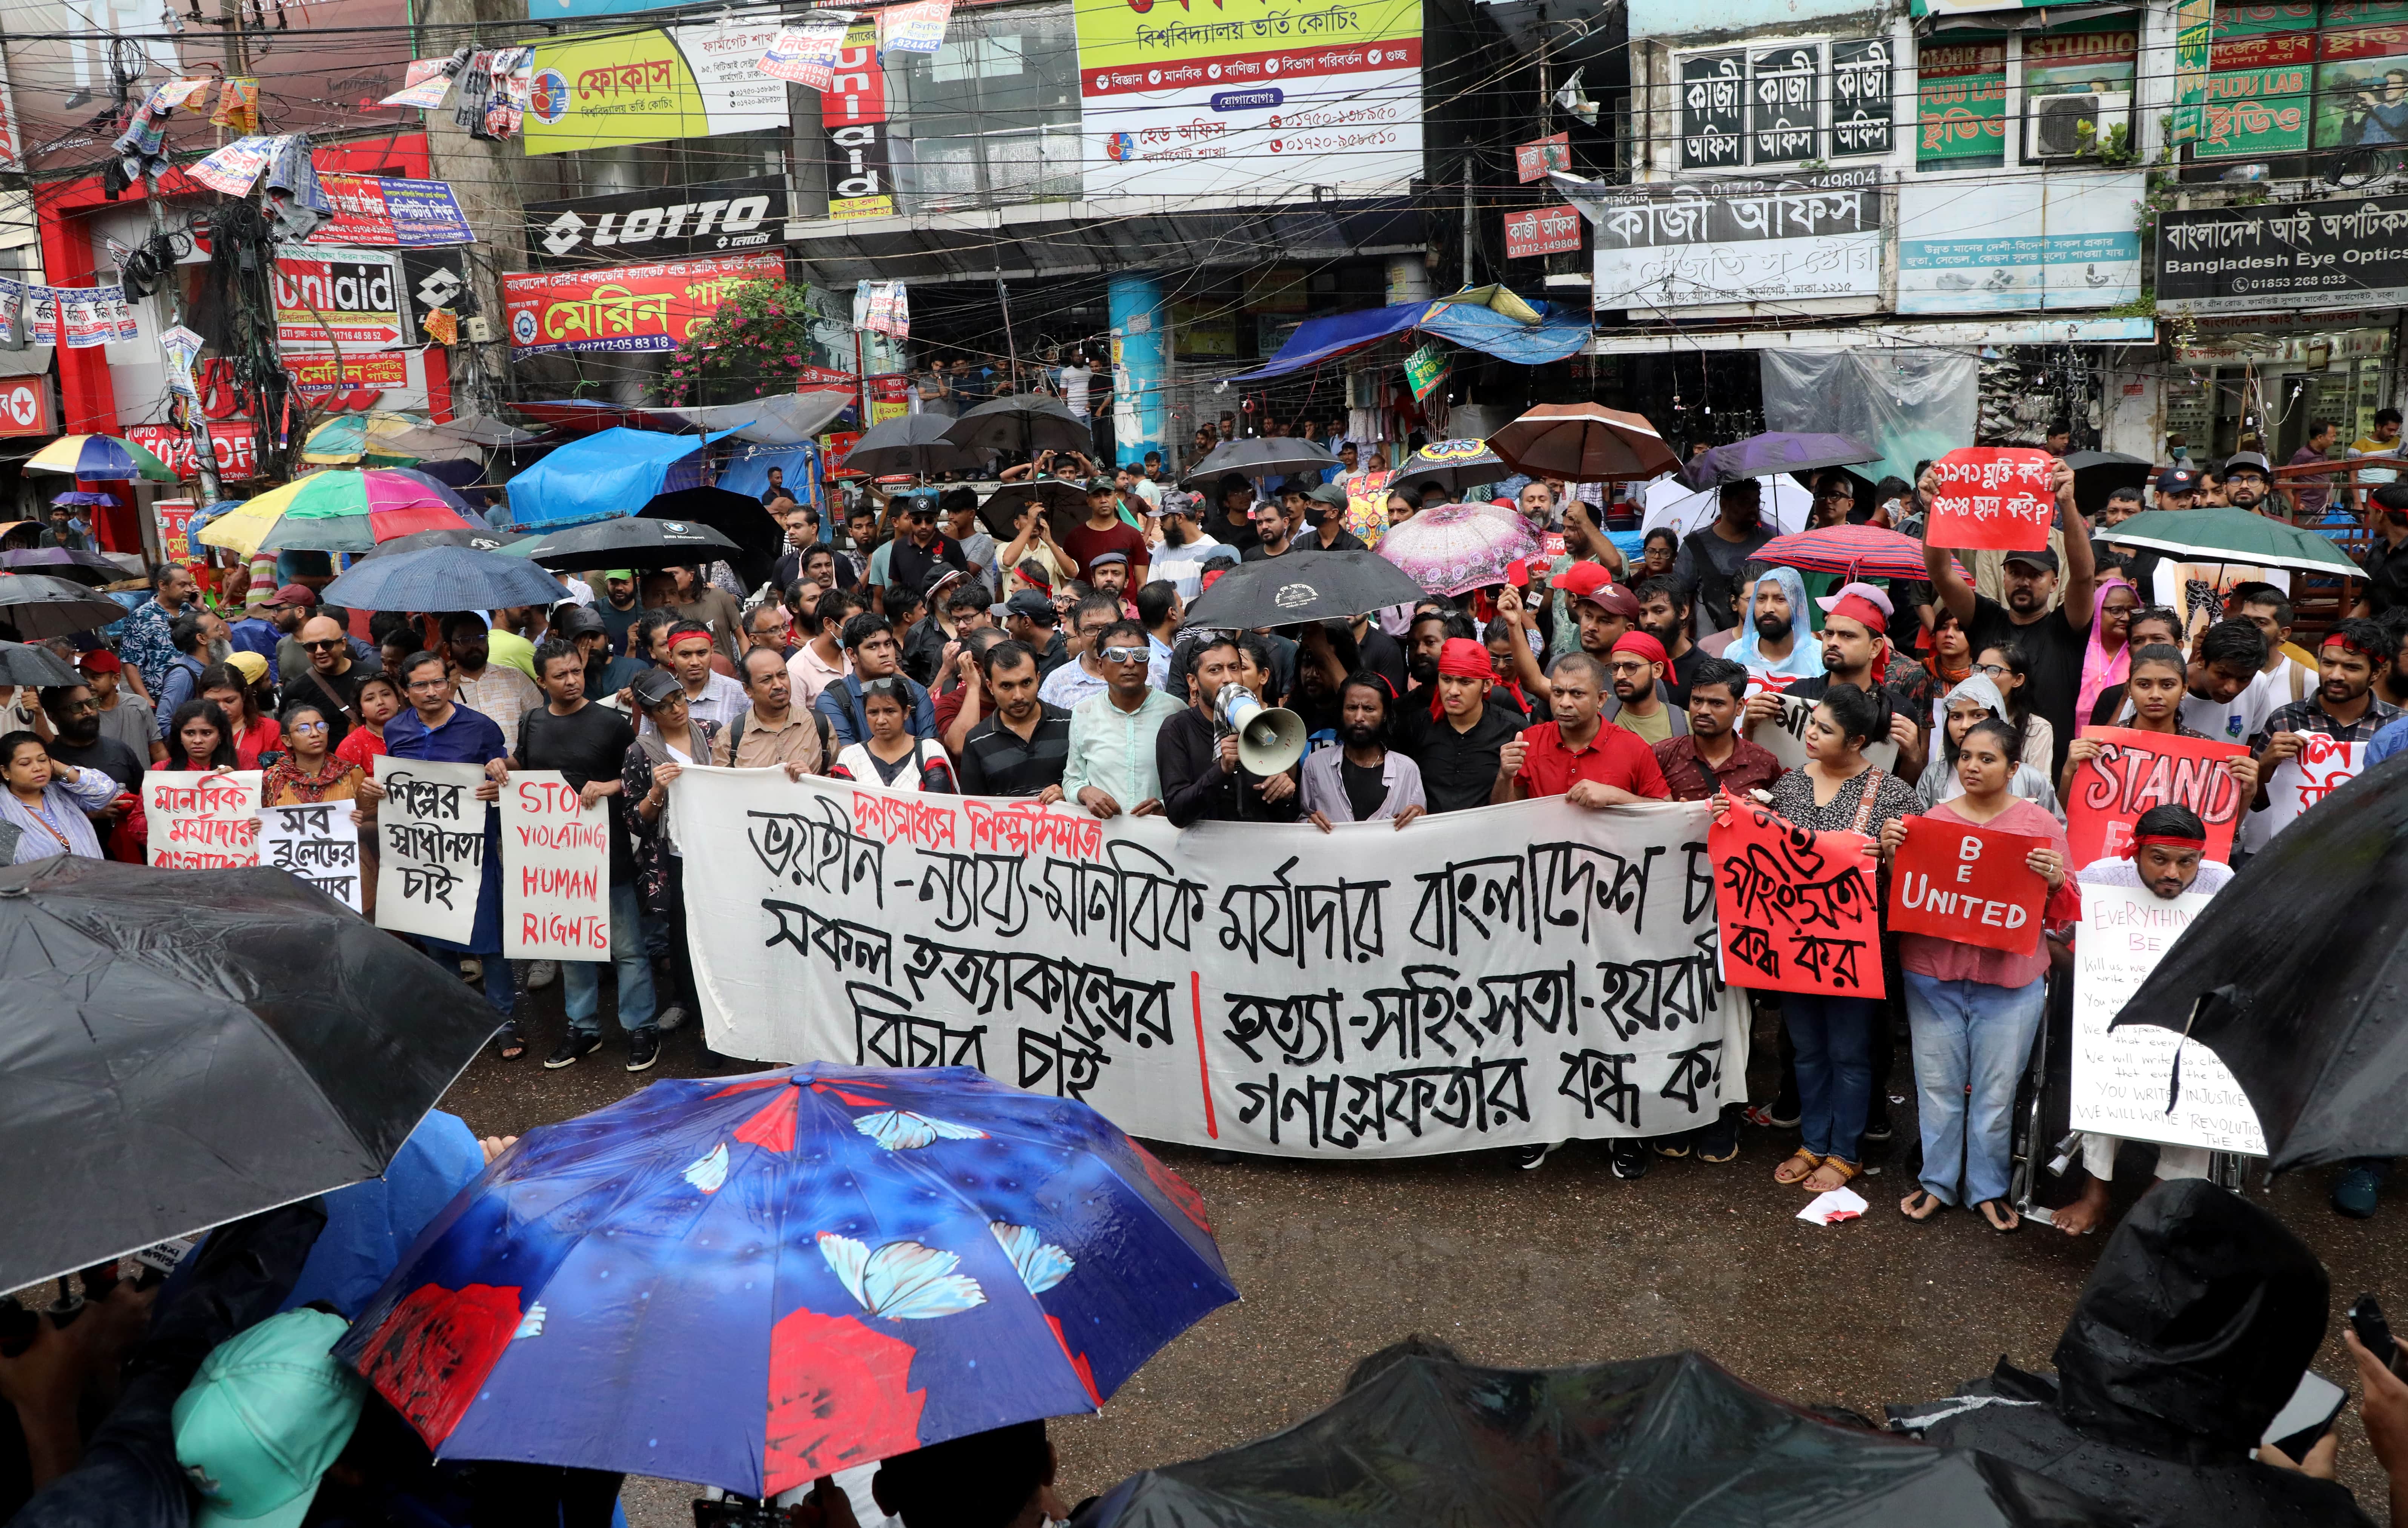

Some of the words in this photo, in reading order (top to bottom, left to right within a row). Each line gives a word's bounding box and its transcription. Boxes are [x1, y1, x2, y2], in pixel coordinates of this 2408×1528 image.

[847, 30, 876, 43] স্যারের
[1136, 21, 1244, 49] বিশ্ববিদ্যালয়
[1250, 9, 1291, 37] ভর্তি
[1299, 5, 1359, 34] কোচিং
[702, 35, 746, 52] ফার্মগেট
[752, 32, 777, 46] শাখা
[778, 35, 839, 53] নিউরন
[2029, 32, 2136, 63] STUDIO
[2276, 36, 2310, 50] ছবি
[714, 60, 737, 72] বিটিআই
[720, 74, 745, 82] ফার্মগেট,
[764, 66, 827, 86] 01855-051279
[767, 61, 829, 77] 01791-381040
[1112, 73, 1143, 87] বিজ্ঞান
[1164, 67, 1202, 83] মানবিক
[1224, 61, 1259, 77] বাণিজ্য
[1282, 55, 1315, 71] বিভাগ
[1318, 50, 1361, 68] পরিবর্তন
[1386, 49, 1407, 61] গুচ্ছ
[1834, 41, 1891, 107] কাজী
[578, 58, 674, 100] ফোকাস
[1685, 58, 1742, 122] কাজী
[1756, 50, 1816, 115] কাজী
[2208, 76, 2258, 98] FUJU
[2264, 73, 2303, 94] LAB
[1921, 84, 1968, 105] FUJU
[1973, 82, 2006, 100] LAB
[581, 101, 626, 118] বিশ্ববিদ্যালয়
[629, 99, 645, 112] ভর্তি
[648, 99, 674, 110] কোচিং
[1140, 126, 1171, 145] হেড
[1176, 118, 1227, 140] অফিস
[1287, 132, 1396, 150] ০১৭২০-৯৫৮৫১০
[1757, 118, 1813, 156] অফিস
[1835, 109, 1890, 149] অফিস
[1198, 146, 1227, 158] শাখা
[1685, 124, 1739, 163] অফিস
[1519, 144, 1539, 169] কাজী
[859, 197, 880, 206] তলা
[1607, 185, 1717, 247] কাজী
[1726, 181, 1869, 238] অফিস
[593, 195, 770, 247] LOTTO
[1508, 213, 1538, 243] কাজী
[1540, 210, 1576, 239] অফিস
[2166, 216, 2264, 252] বাংলাদেশ
[2269, 209, 2315, 245] আই
[1510, 238, 1579, 255] 01712-149804
[1906, 257, 1931, 267] জুতা,
[2013, 253, 2037, 263] সুলভ
[2071, 250, 2101, 258] পাওয়া
[1924, 244, 1950, 255] উন্নত
[2054, 240, 2080, 249] সকল
[2084, 238, 2114, 247] প্রকার
[506, 276, 548, 291] বাংলাদেশ
[551, 273, 577, 287] মেরিন
[581, 268, 623, 283] একাডেমি
[628, 264, 665, 279] ক্যাডেট
[691, 259, 717, 274] রেটিং
[2166, 256, 2288, 274] Bangladesh
[2297, 252, 2335, 268] Eye
[276, 264, 393, 311] uniaid
[1794, 282, 1852, 294] ঢাকা-১২১৫
[2251, 278, 2290, 289] 01853
[2295, 276, 2318, 286] 268
[2323, 275, 2346, 285] 033
[544, 284, 677, 340] মেরিন
[2208, 299, 2222, 308] গ্রীন
[2248, 296, 2277, 306] ফার্মভিউ
[2281, 296, 2301, 307] সুপার
[2304, 293, 2330, 303] মার্কেট,
[345, 315, 372, 323] প্রাইভেট
[635, 338, 650, 349] 83
[654, 336, 668, 347] 18
[366, 360, 402, 371] কোচিং
[367, 371, 402, 381] গাইড
[134, 427, 157, 437] UPTO
[1937, 463, 1980, 483] ১৯৭১
[1983, 457, 2014, 490] মুক্তি
[1934, 496, 1970, 517] ২০২৪
[1973, 496, 2003, 522] ছাত্র
[2006, 492, 2048, 525] কই?
[155, 775, 253, 813] মানবিক
[384, 772, 467, 820] শিল্পের
[1864, 774, 1880, 799] KORS
[2086, 742, 2241, 825] STAND
[170, 813, 254, 847] মর্যাদার
[276, 805, 336, 835] সব
[269, 834, 356, 867] বুলেটের
[385, 822, 485, 866] স্বাধীনতা
[517, 822, 606, 855] VIOLATING
[397, 863, 463, 911] চাই
[523, 865, 598, 903] HUMAN
[1219, 856, 1391, 969] মর্যাদার
[1410, 841, 1666, 956] বাংলাদেশ
[1902, 871, 2027, 929] UNITED
[523, 912, 607, 949] RIGHTS
[762, 899, 892, 986] সকল
[2130, 933, 2161, 951] BE
[1729, 923, 1780, 979] বন্ধ
[1789, 936, 1866, 987] কর
[2084, 956, 2105, 973] Kill
[2084, 993, 2105, 1006] You
[2084, 1023, 2099, 1035] We
[2133, 1026, 2162, 1035] speak
[2115, 1037, 2140, 1045] that
[2150, 1039, 2175, 1047] even
[1018, 1024, 1110, 1103] চাই
[2086, 1049, 2104, 1063] We
[2113, 1054, 2133, 1064] will
[2142, 1054, 2171, 1064] write
[2115, 1067, 2140, 1077] that
[2186, 1069, 2207, 1079] the
[1559, 1048, 1640, 1128] বন্ধ
[2096, 1082, 2126, 1098] YOU
[2077, 1105, 2101, 1119] WE
[2107, 1106, 2135, 1120] WILL
[2140, 1108, 2179, 1125] WRITE
[2202, 1132, 2233, 1147] THE
